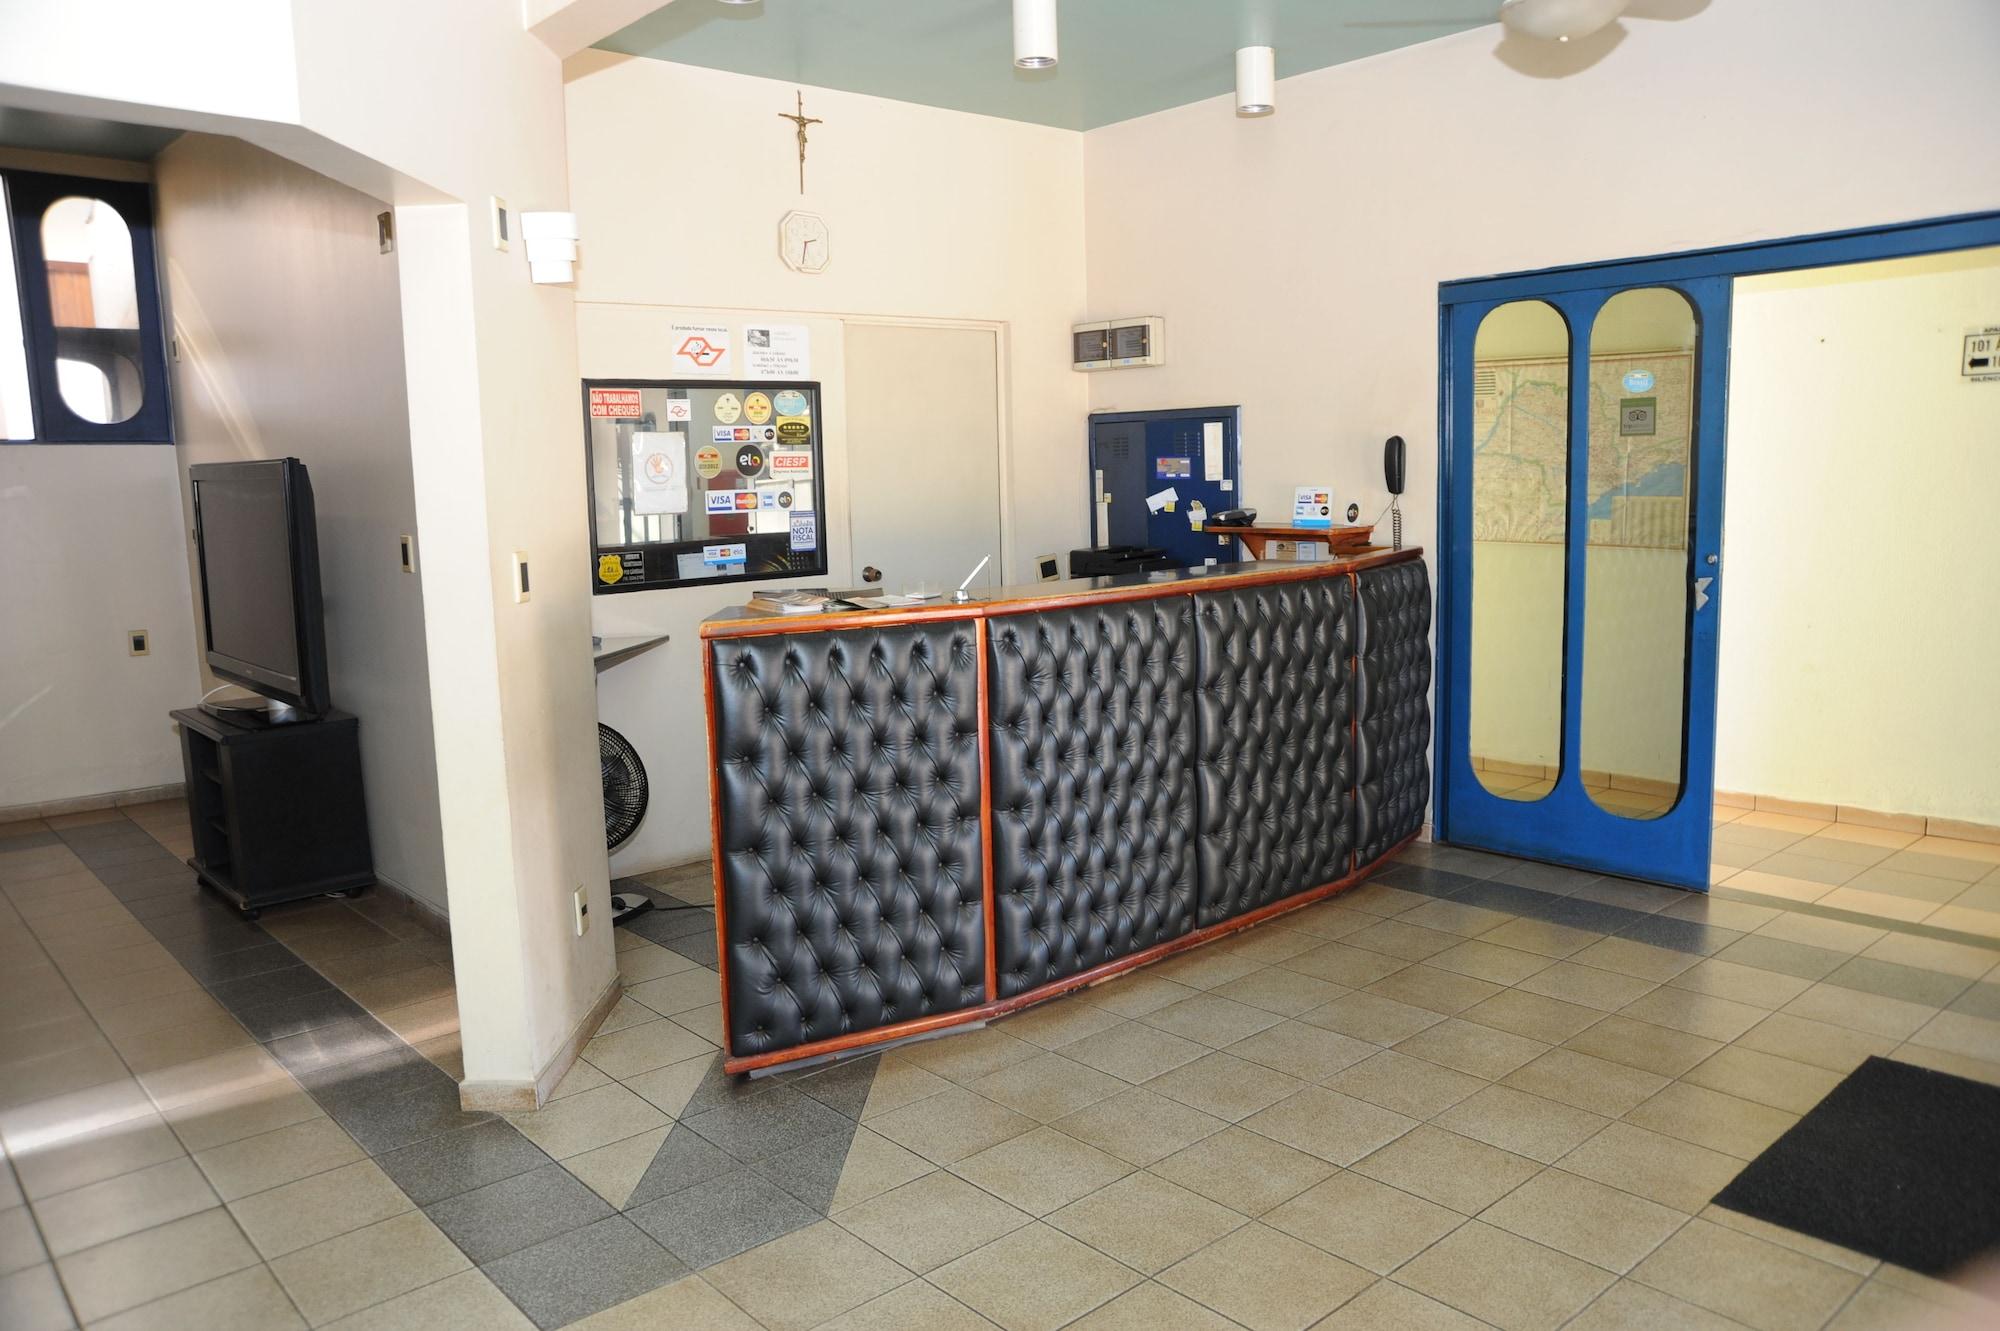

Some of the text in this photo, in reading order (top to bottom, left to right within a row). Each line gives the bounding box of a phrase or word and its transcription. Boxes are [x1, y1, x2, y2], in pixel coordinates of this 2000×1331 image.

[1972, 340, 1990, 352] 101
[592, 391, 639, 404] NÃO TRABALHAMOS
[592, 404, 640, 416] COM CHEQUES
[739, 454, 760, 467] elo
[775, 457, 807, 467] CIESP
[711, 495, 731, 504] VISA
